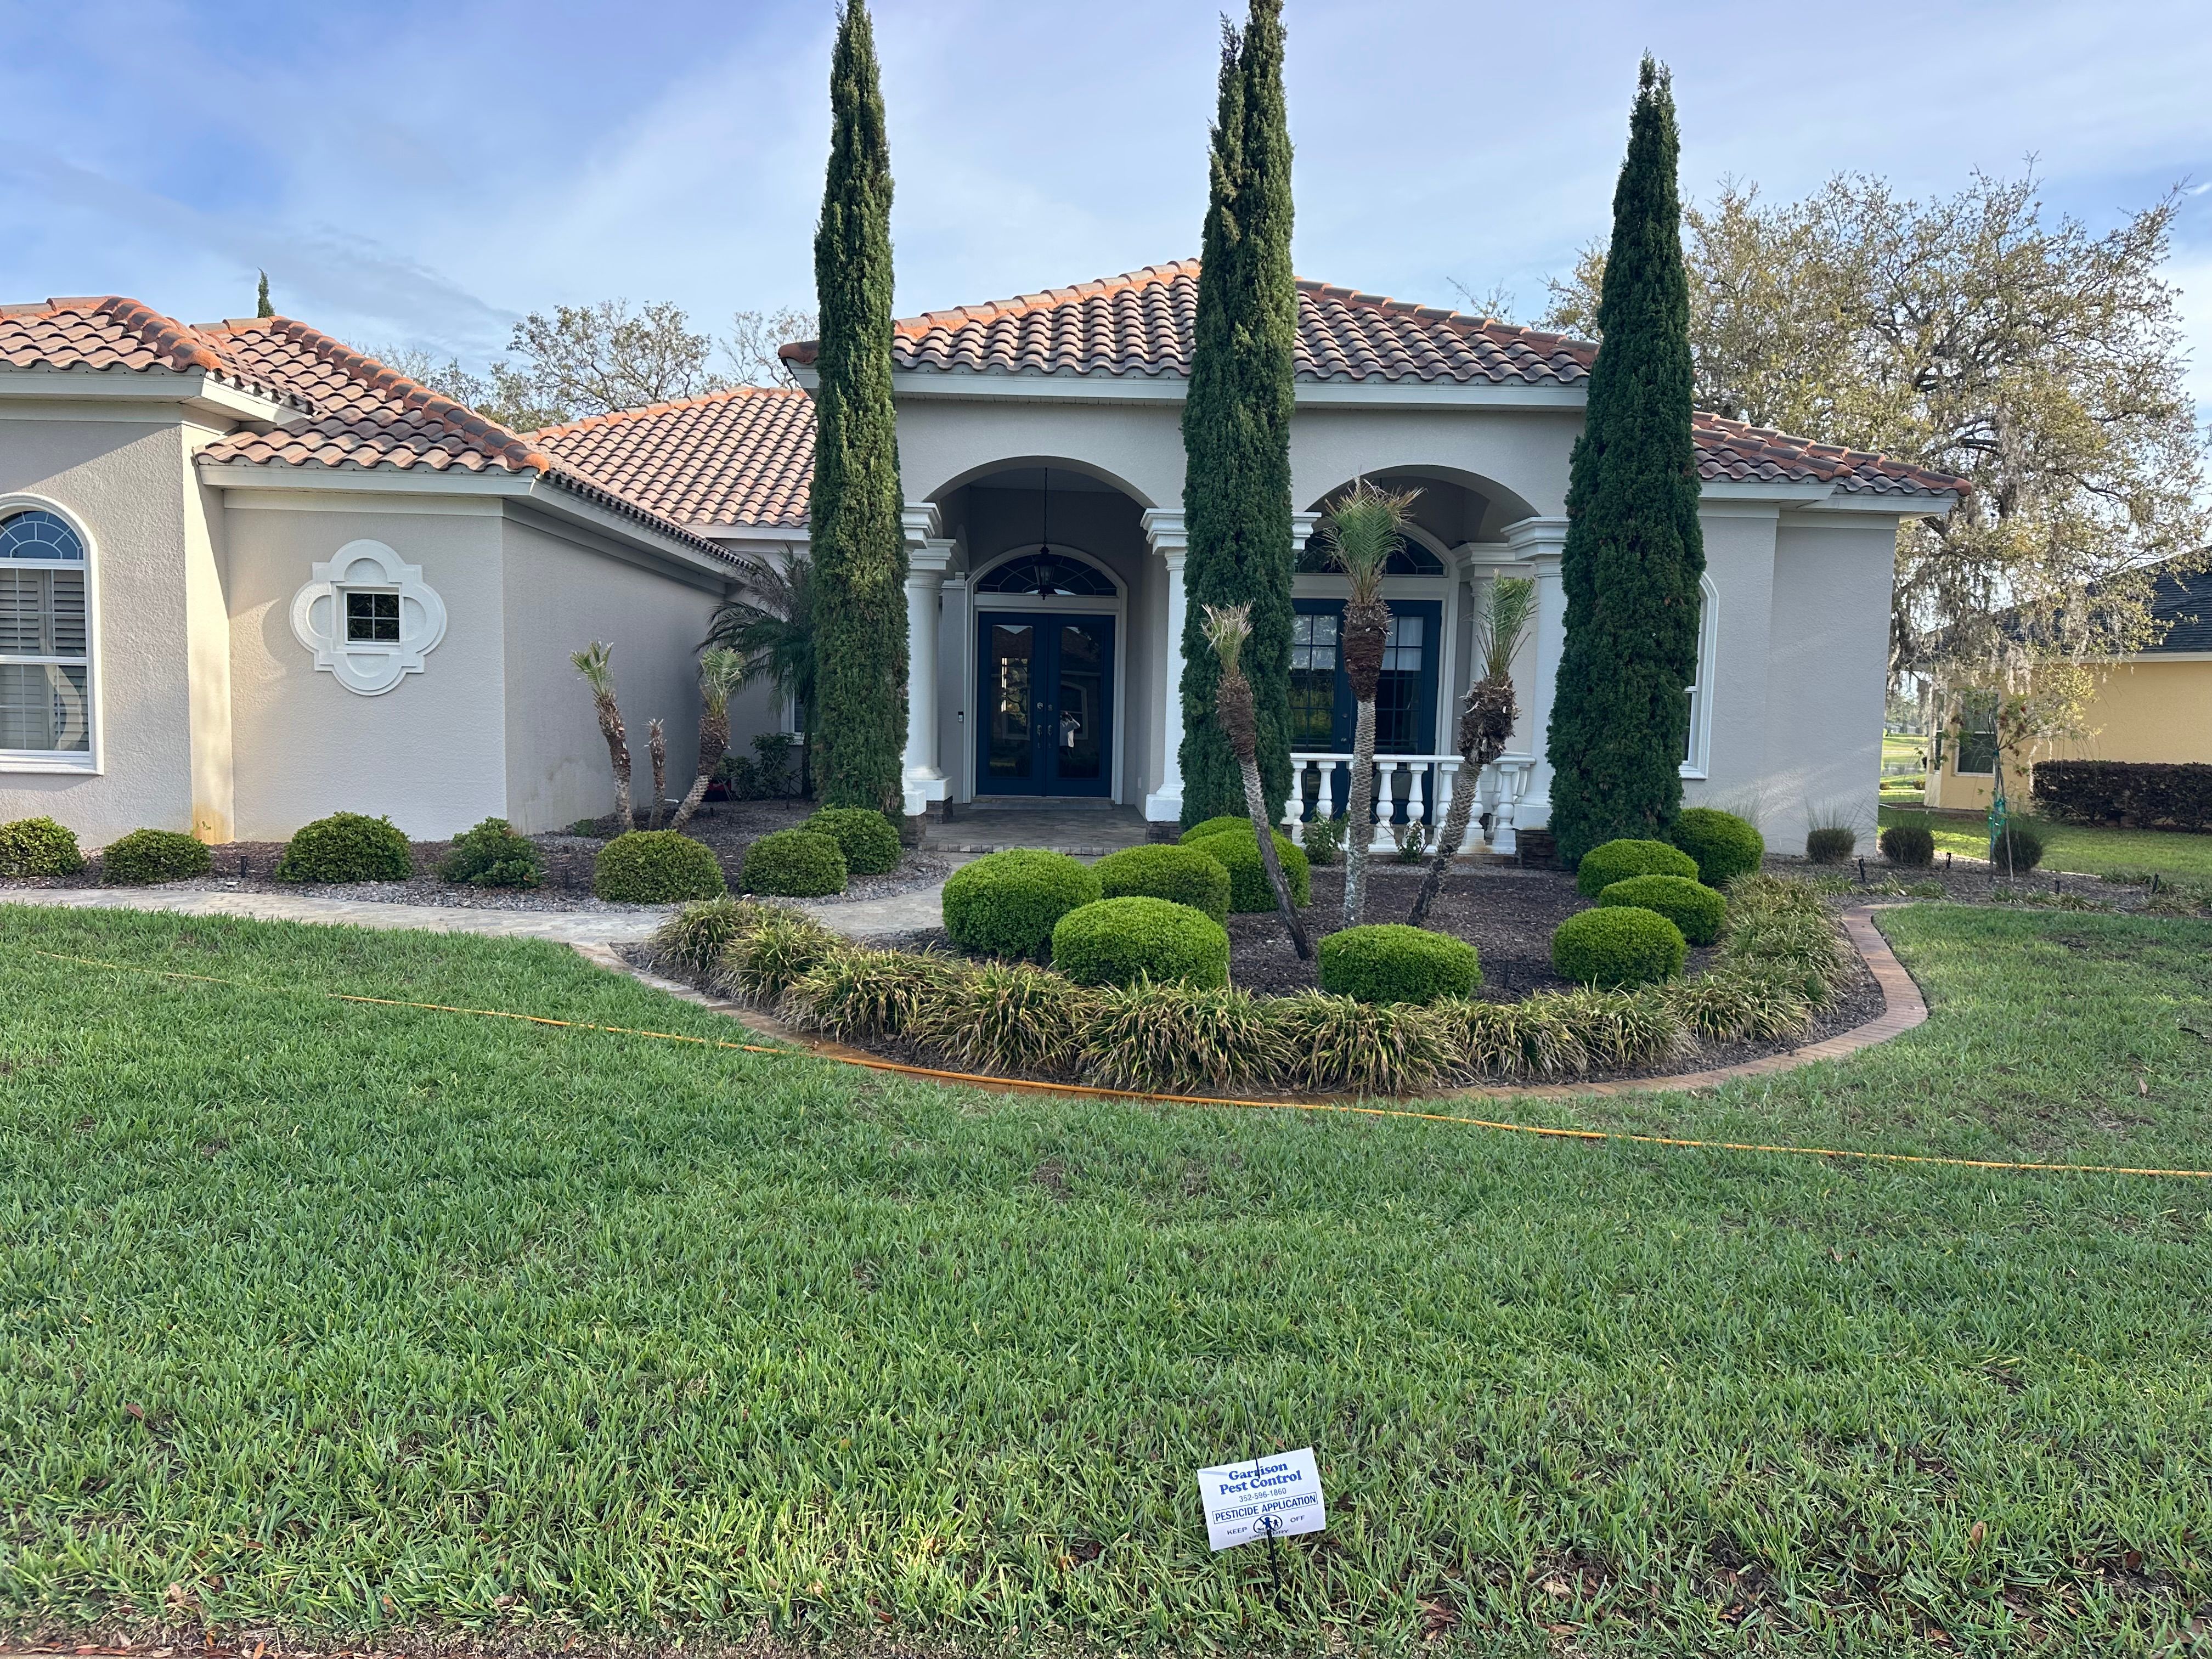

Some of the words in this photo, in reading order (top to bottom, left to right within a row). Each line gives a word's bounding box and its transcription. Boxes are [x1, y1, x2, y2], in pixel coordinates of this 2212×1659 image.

[1219, 1481, 1248, 1495] Pest
[1250, 1470, 1302, 1488] Control
[1239, 1487, 1286, 1502] 352-596-1860
[1215, 1505, 1259, 1521] PESTICIDE
[1262, 1494, 1316, 1513] APPLICATION
[1227, 1527, 1248, 1535] KEEP
